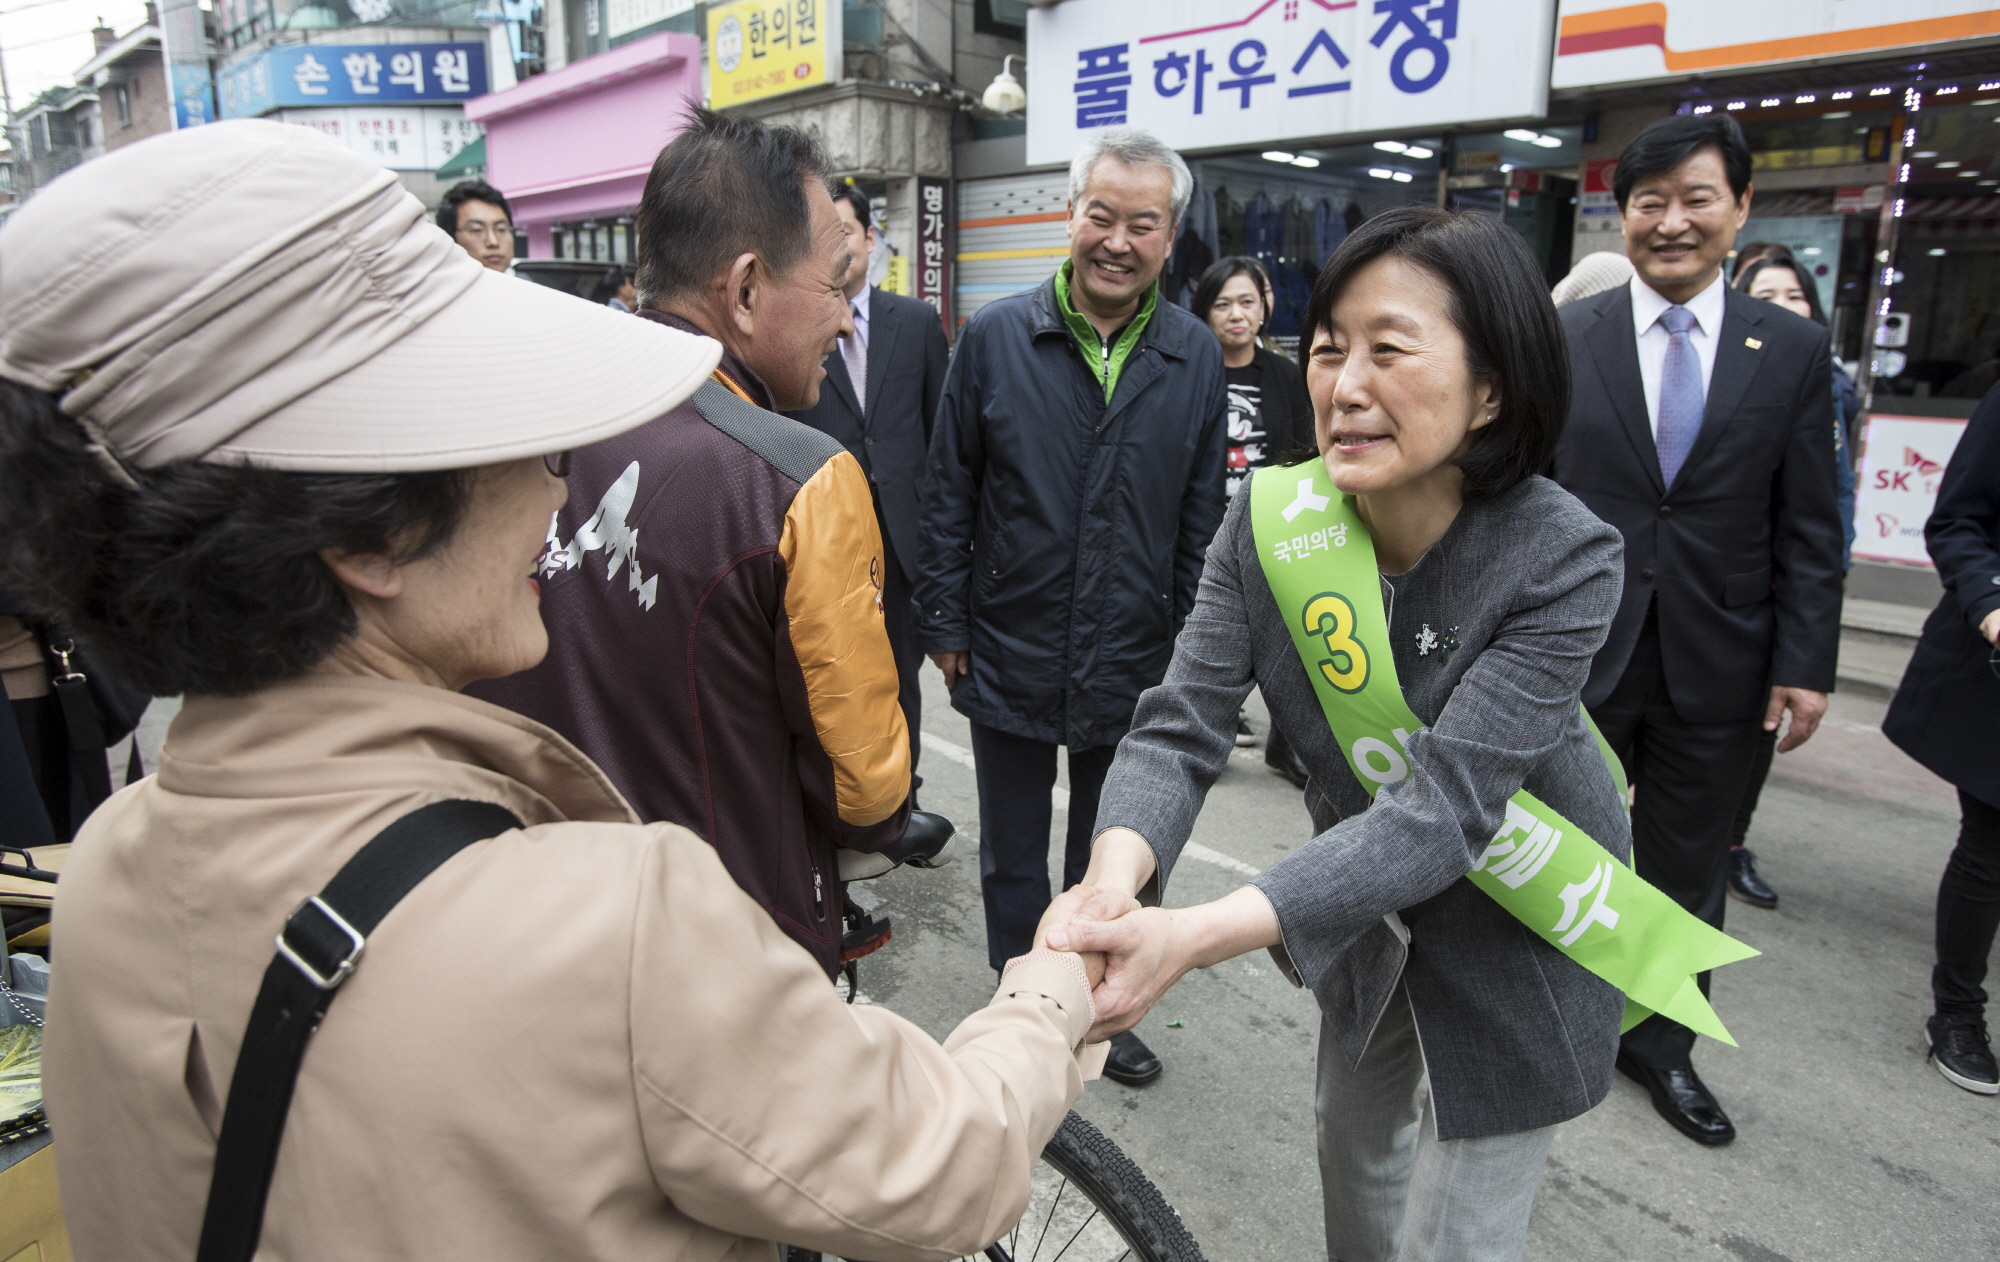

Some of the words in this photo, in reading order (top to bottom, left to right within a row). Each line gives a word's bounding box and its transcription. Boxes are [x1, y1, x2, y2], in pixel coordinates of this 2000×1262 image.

[749, 0, 816, 59] 한의원
[1873, 469, 1912, 492] SK
[1273, 523, 1348, 563] 국민의당
[1302, 591, 1371, 695] 3
